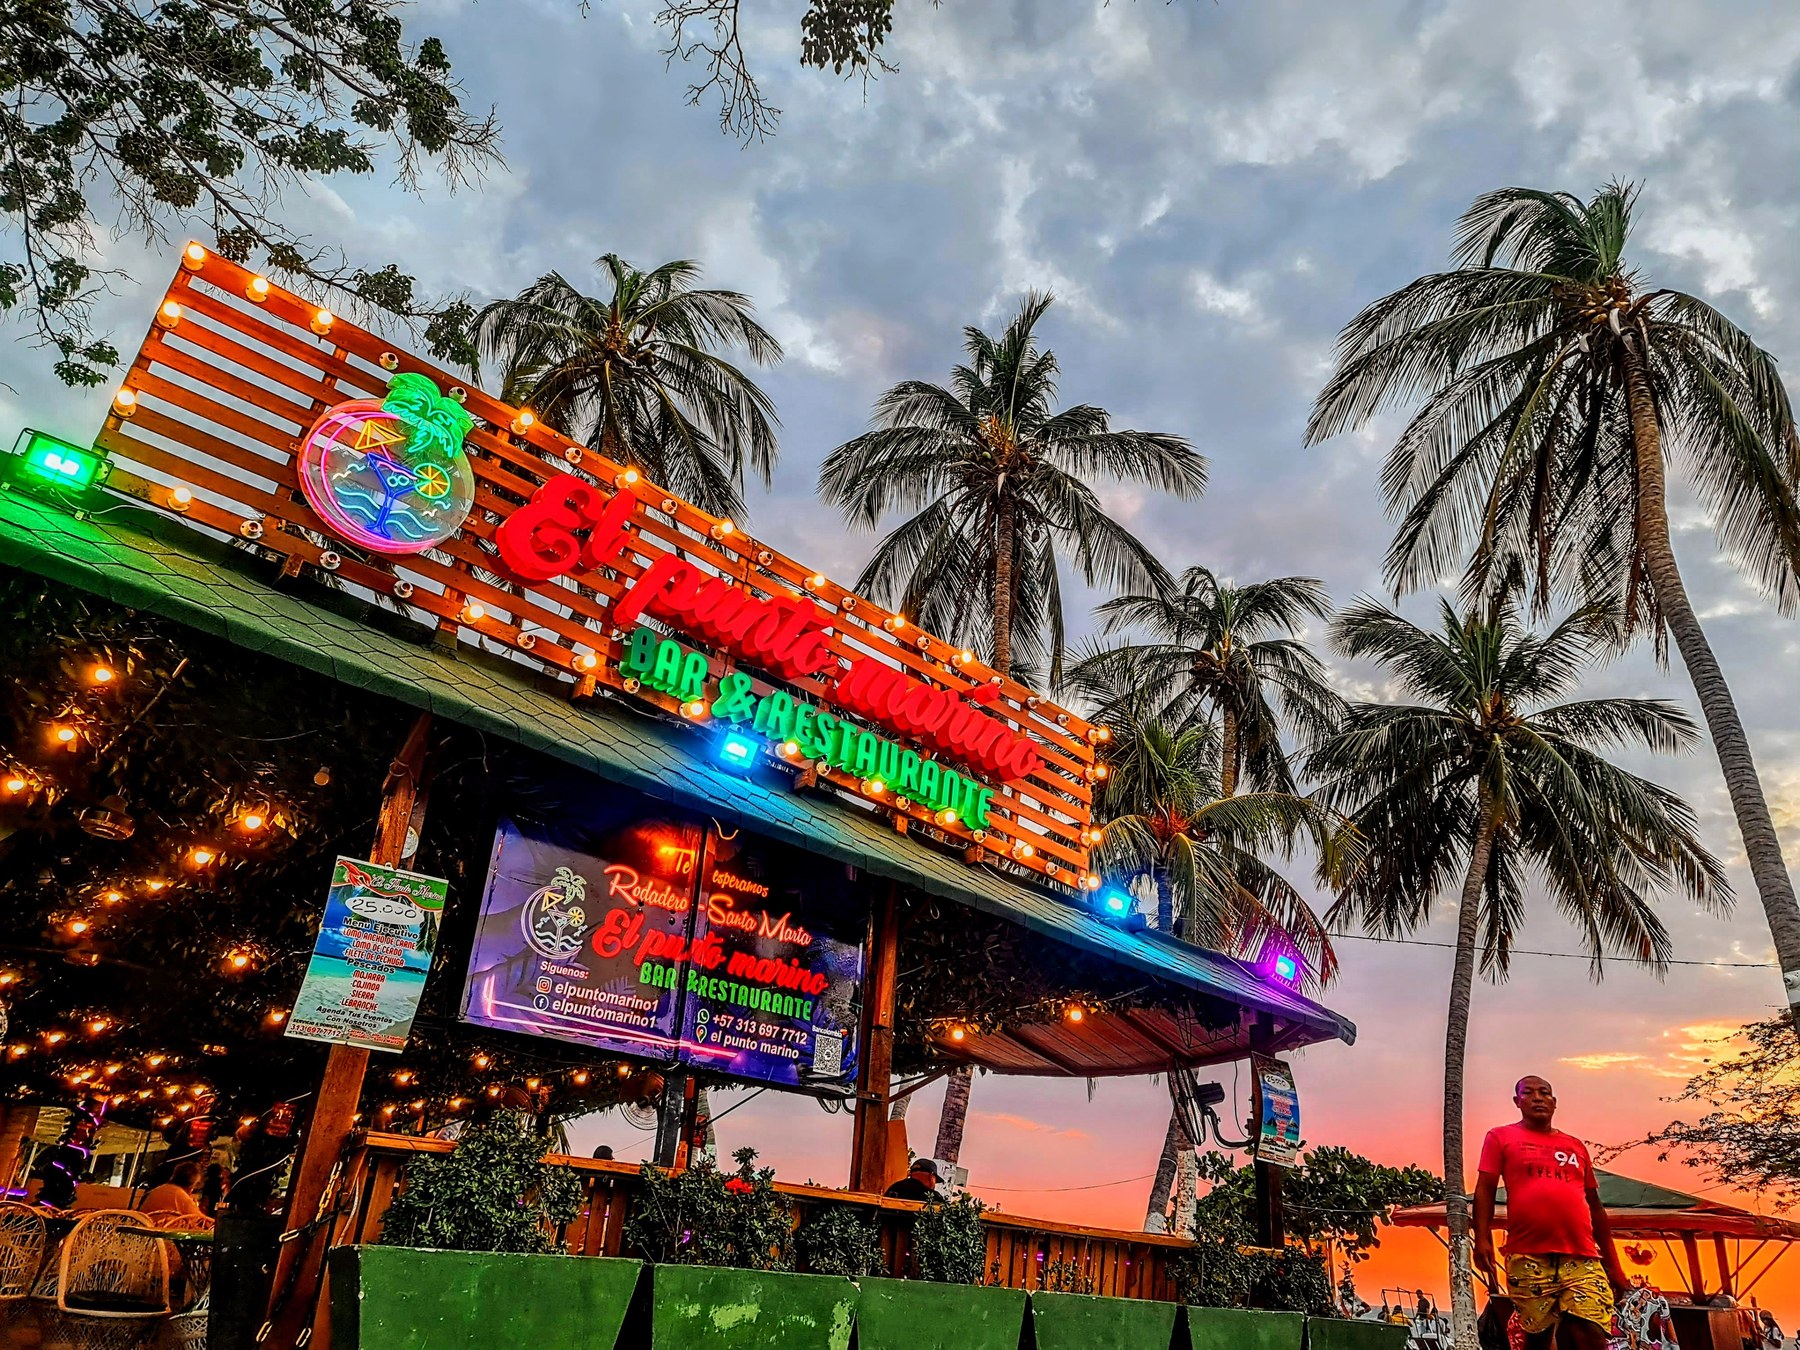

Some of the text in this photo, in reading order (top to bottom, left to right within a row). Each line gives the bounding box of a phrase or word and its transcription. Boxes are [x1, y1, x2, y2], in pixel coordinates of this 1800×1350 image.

[495, 474, 1046, 782] El punto marino
[620, 627, 995, 830] BAR & RESTAURANTE
[673, 847, 692, 874] Te
[711, 868, 769, 898] esperamos
[603, 864, 688, 911] Rodadero
[707, 893, 758, 932] Santa
[758, 909, 812, 946] Marta
[343, 928, 362, 939] LOMO
[352, 939, 371, 950] LOMO
[373, 923, 419, 939] Ejecutivo
[347, 958, 395, 974] Pescados
[592, 908, 829, 995] El punto marino
[640, 961, 677, 990] BAR
[555, 981, 659, 1013] elpuntomarino1
[316, 1005, 393, 1024] Agenda Tus Eventos
[326, 1015, 377, 1029] Con Nosotros
[552, 998, 657, 1028] elpuntomarino1
[712, 1014, 808, 1045] +57 313 697 7712
[811, 1025, 843, 1038] Bancolombia
[710, 1030, 799, 1059] el punto marino
[1554, 1151, 1580, 1169] 94
